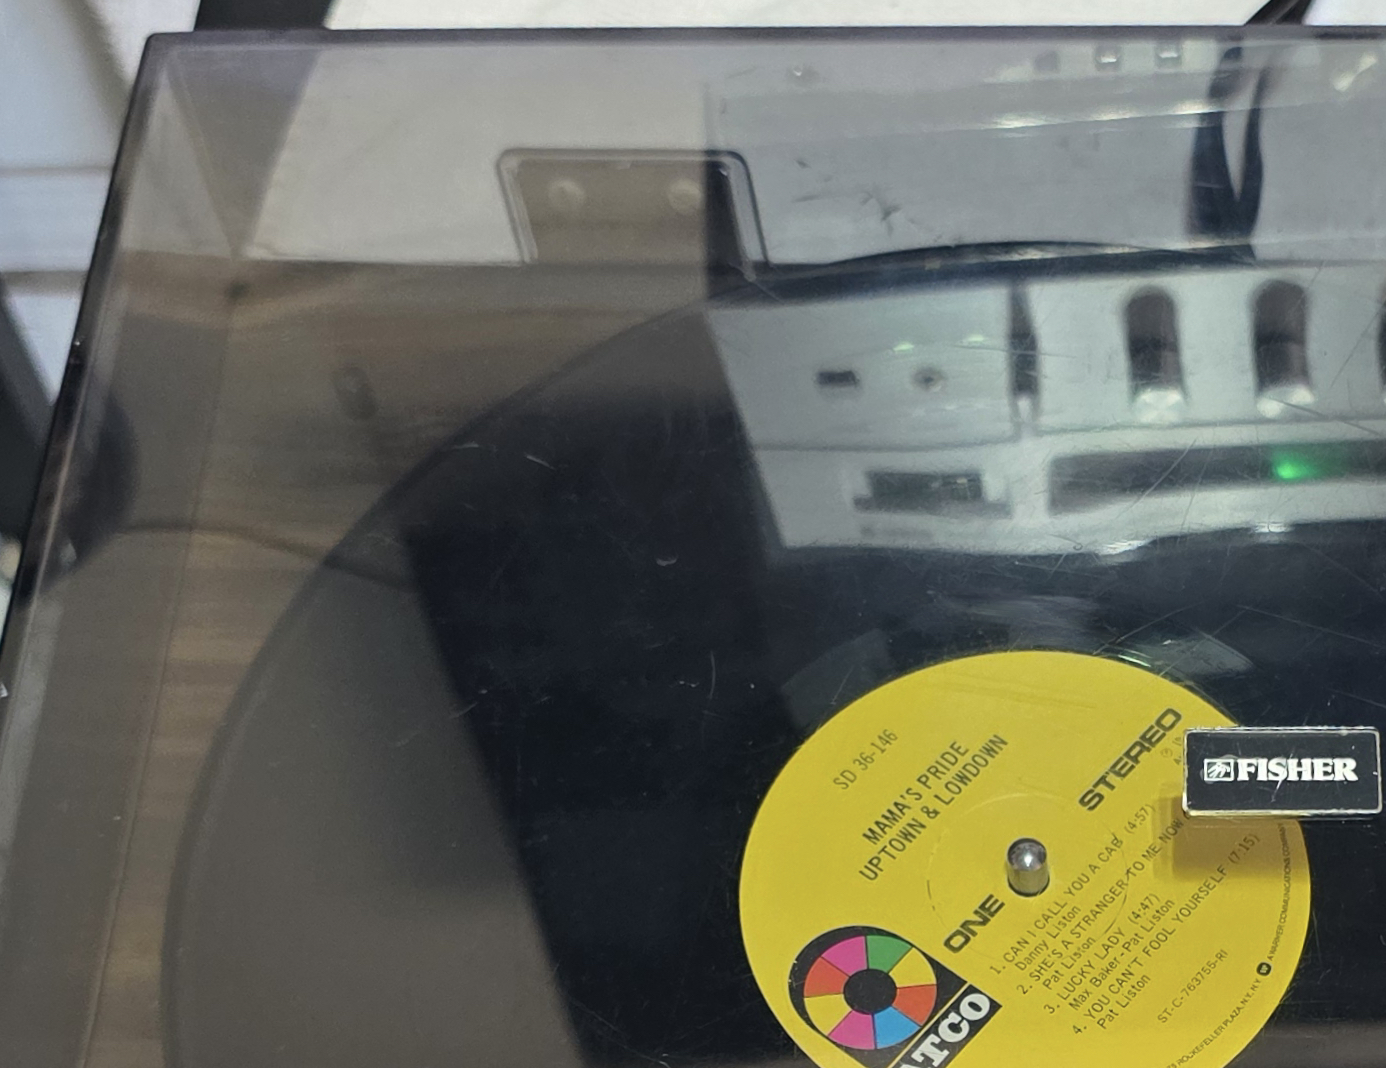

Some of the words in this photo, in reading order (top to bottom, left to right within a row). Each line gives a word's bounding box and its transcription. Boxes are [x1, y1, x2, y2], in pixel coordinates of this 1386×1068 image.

[833, 769, 857, 790] SD
[853, 729, 898, 771] 36-146
[858, 818, 927, 881] UPTOWN
[920, 805, 941, 819] &
[933, 734, 1008, 805] LOWDOWN
[862, 787, 923, 846] MAMA'S
[916, 741, 970, 790] PRIDE
[1078, 708, 1182, 811] STEREO
[1237, 758, 1358, 781] FISHER
[943, 894, 1005, 953] ONE
[1003, 937, 1029, 963] CAN
[1034, 901, 1067, 930] CALL
[1063, 872, 1090, 896] YOU
[1088, 863, 1100, 874] A
[1097, 836, 1123, 862] CAB
[1124, 804, 1156, 834] (4:57)
[1016, 984, 1033, 995] 2.
[1029, 949, 1063, 982] SHE'S
[1061, 939, 1074, 950] A
[1070, 878, 1128, 939] STRANGER
[1127, 861, 1145, 877] TO
[1141, 843, 1161, 861] ME
[1158, 818, 1184, 844] NOW
[1014, 940, 1049, 971] Danny
[1046, 905, 1081, 939] Liston
[1042, 969, 1064, 990] Pat
[1061, 936, 1097, 969] Liston
[1043, 1003, 1060, 1014] 3.
[1056, 960, 1095, 1000] LUCKY
[1094, 927, 1125, 960] LADY
[1128, 893, 1161, 925] (4:47)
[1068, 988, 1092, 1011] Max
[1140, 899, 1176, 933] Liston
[1072, 1024, 1087, 1034] 4.
[1083, 994, 1111, 1021] YOU
[1108, 956, 1144, 995] CAN'T
[1142, 928, 1176, 958] FOOL
[1171, 864, 1228, 925] YOURSELF
[1096, 1009, 1119, 1030] Pat
[1115, 974, 1152, 1008] Liston
[1176, 1025, 1226, 1066] ROCKEFELLER
